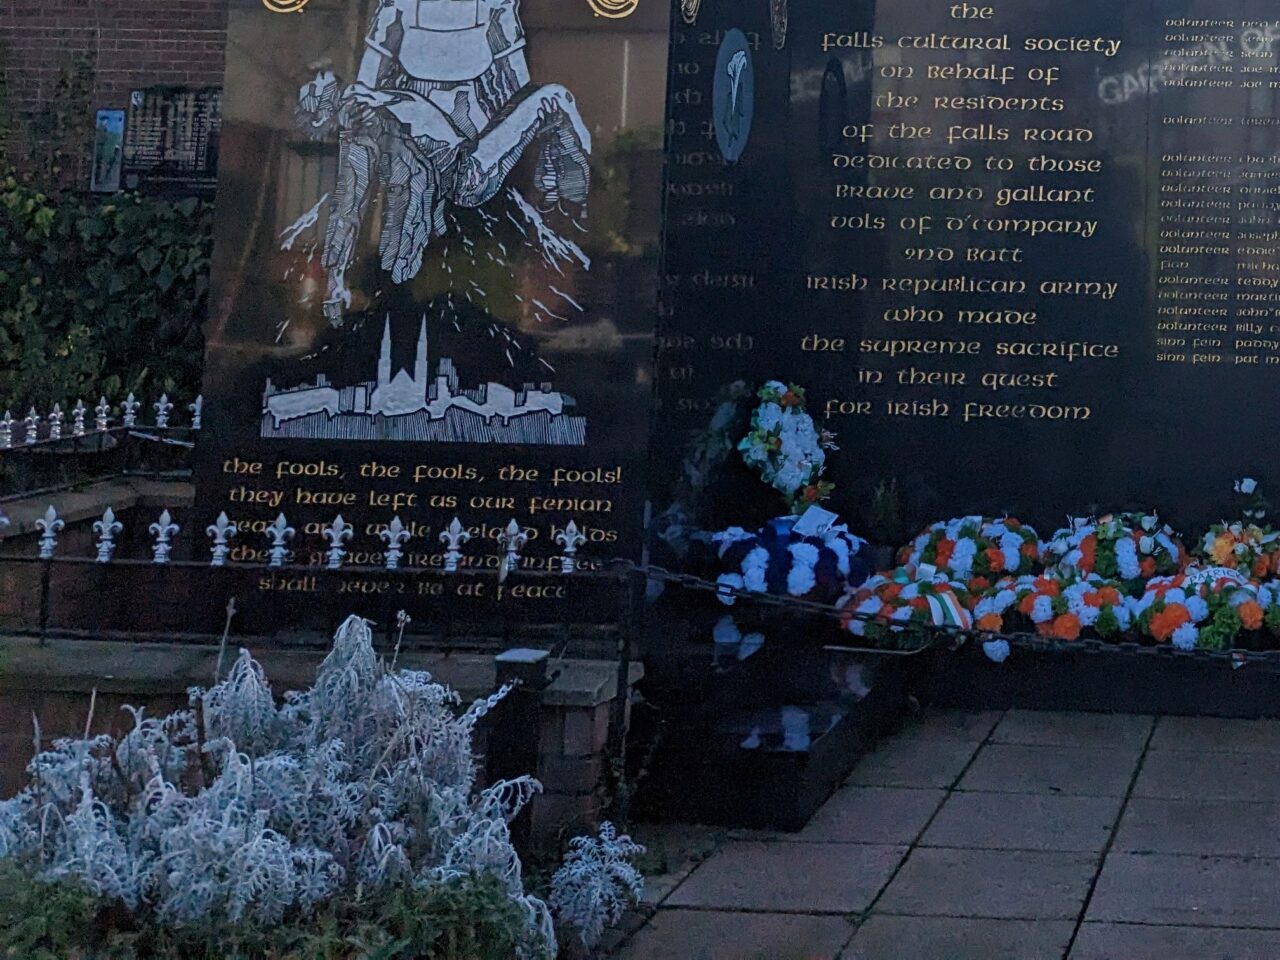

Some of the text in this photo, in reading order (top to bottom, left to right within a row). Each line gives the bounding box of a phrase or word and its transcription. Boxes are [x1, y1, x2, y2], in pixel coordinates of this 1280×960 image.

[951, 3, 994, 19] the
[821, 32, 1120, 56] falls cultural society
[881, 64, 1059, 85] on behalf of
[1097, 40, 1231, 104] GARDN
[876, 93, 1064, 111] the residents
[842, 123, 1092, 144] of the falls road
[833, 153, 1102, 172] dedicated to those
[835, 184, 1094, 206] brave and gallant
[830, 213, 885, 230] vols
[900, 216, 932, 234] of
[967, 248, 1023, 263] batt
[807, 274, 1118, 299] irish republican army
[883, 308, 1037, 325] who made
[801, 335, 1119, 362] the supreme sacrifice
[859, 367, 1057, 390] in their quest
[824, 398, 1091, 422] for irish freedom
[223, 458, 621, 486] the fools, the fools, the fools!
[229, 486, 611, 512] they have left us our fenian
[551, 526, 618, 543] hlds
